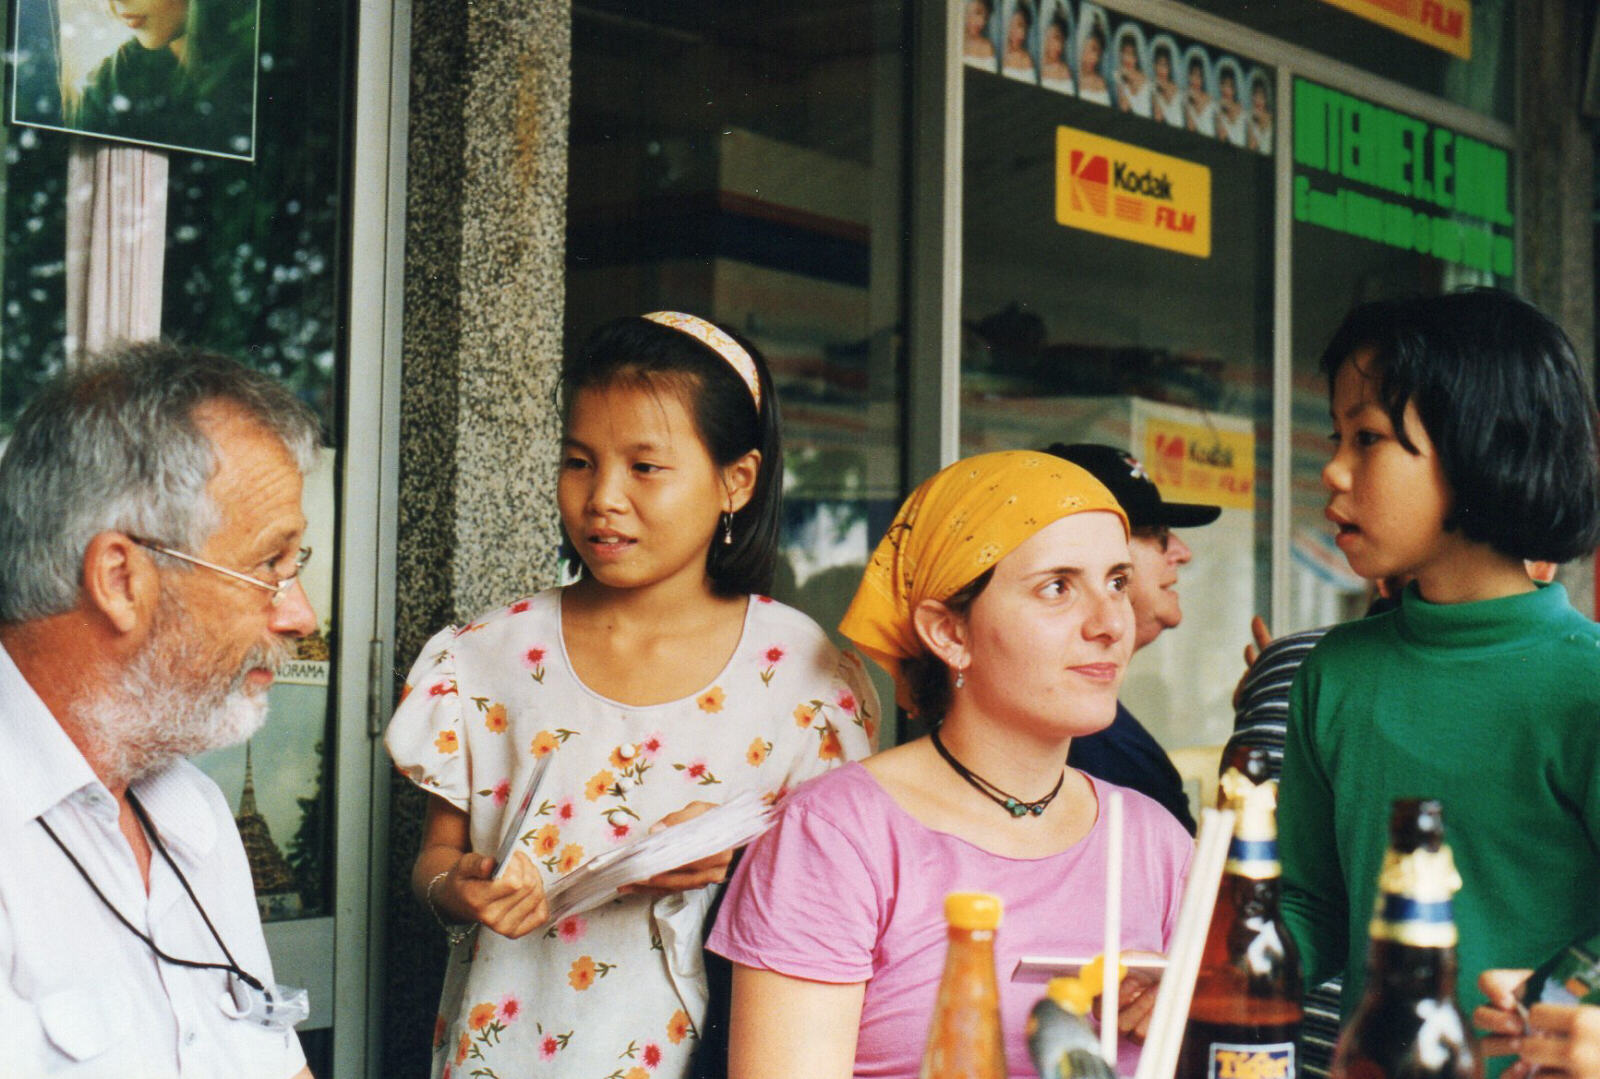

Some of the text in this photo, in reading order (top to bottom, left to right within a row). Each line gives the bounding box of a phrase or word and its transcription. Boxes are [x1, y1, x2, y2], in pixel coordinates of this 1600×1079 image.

[1113, 161, 1173, 201] Kodak
[1155, 205, 1196, 235] FILM
[1190, 442, 1234, 469] Kodak
